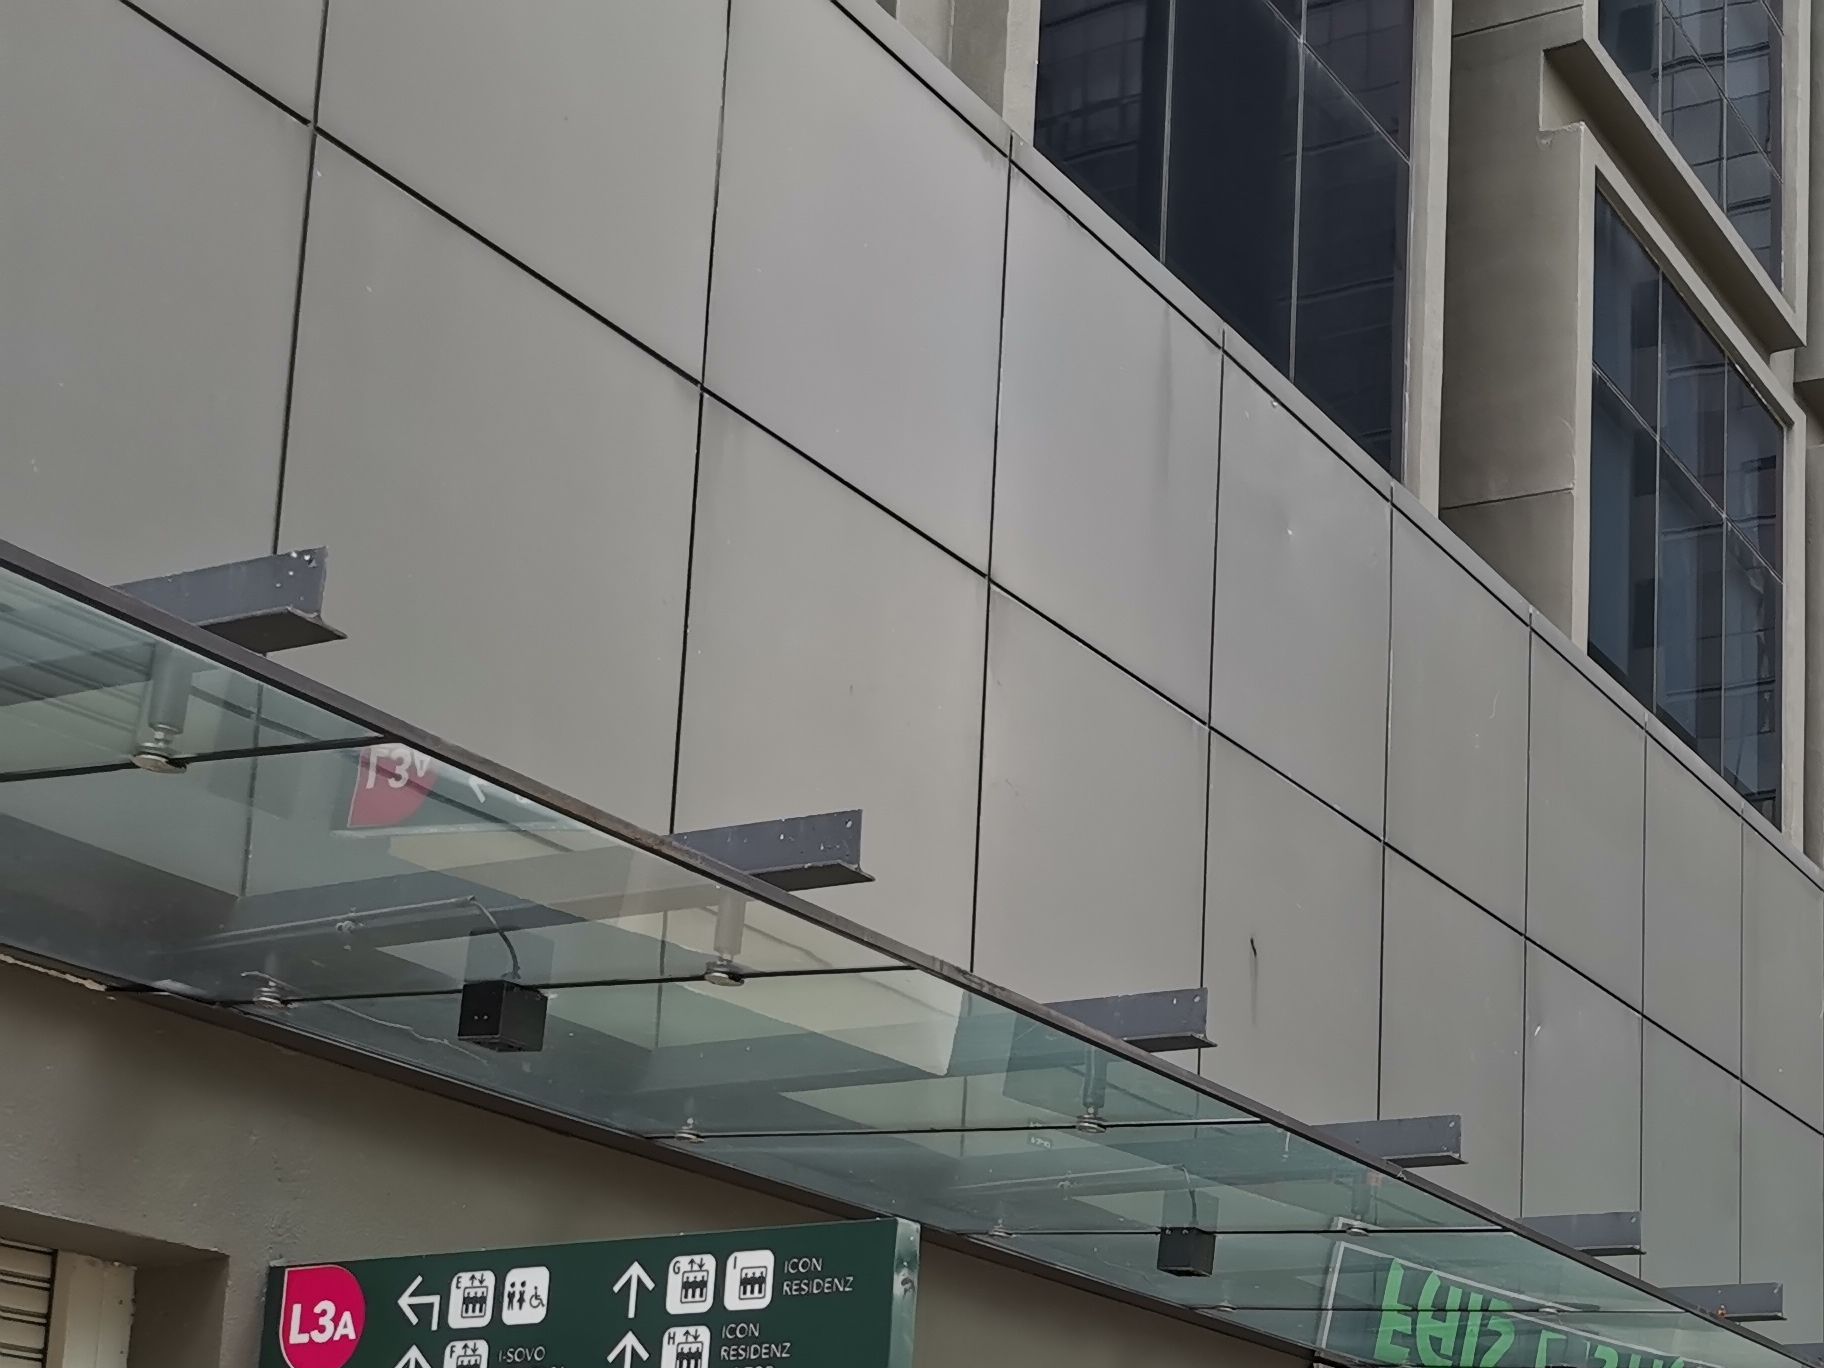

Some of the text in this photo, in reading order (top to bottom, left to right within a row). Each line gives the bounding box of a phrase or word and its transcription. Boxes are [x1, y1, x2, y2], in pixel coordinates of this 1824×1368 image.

[672, 1260, 681, 1274] G
[784, 1258, 823, 1274] ICON
[455, 1276, 463, 1289] E
[783, 1277, 854, 1296] RESIDENZ
[289, 1300, 356, 1344] L3A
[668, 1331, 676, 1345] H
[721, 1323, 760, 1339] ICON
[450, 1345, 456, 1359] F
[499, 1346, 546, 1363] I-SOVO
[720, 1343, 791, 1361] RESIDENZ
